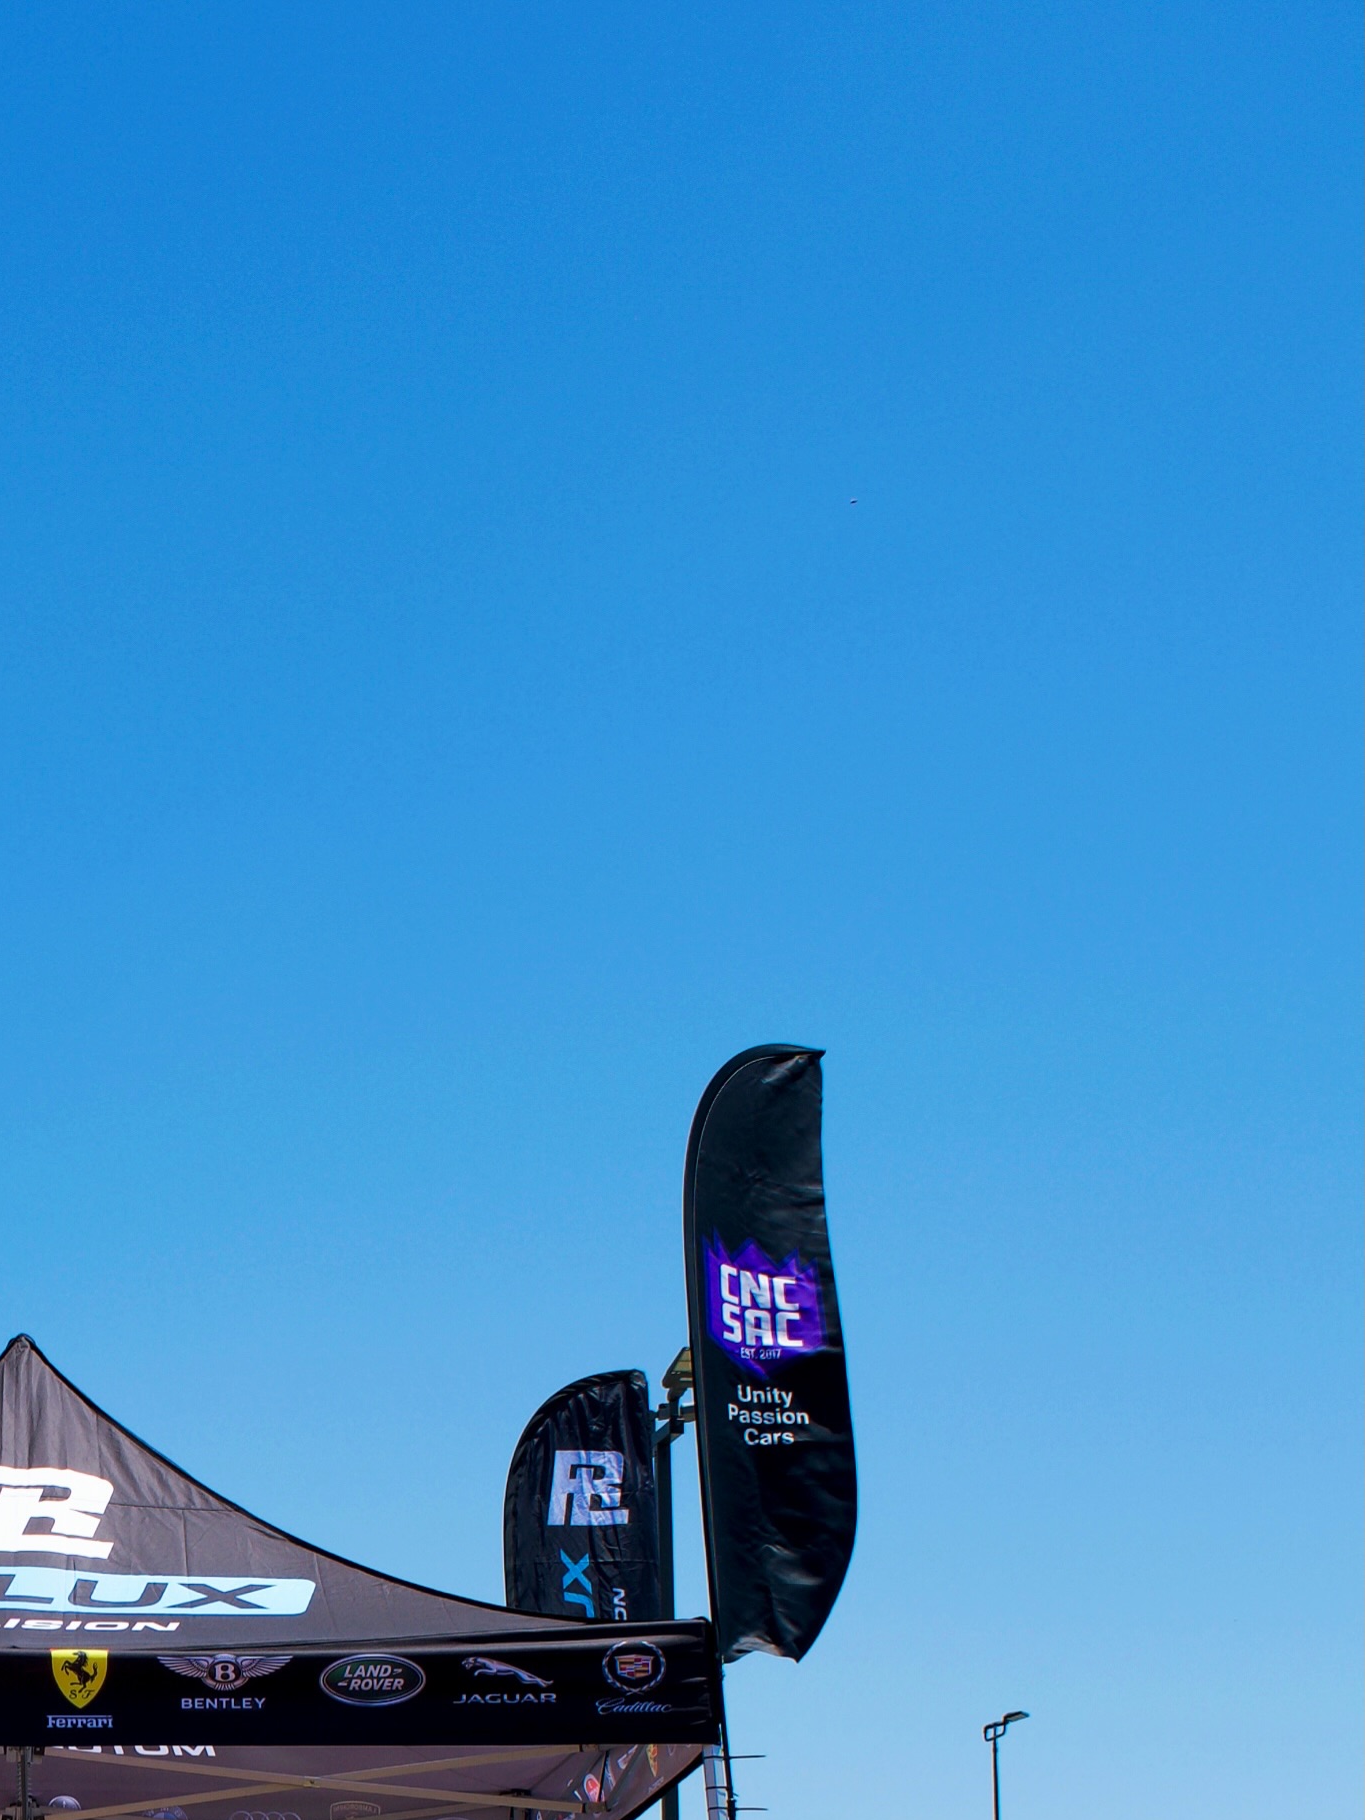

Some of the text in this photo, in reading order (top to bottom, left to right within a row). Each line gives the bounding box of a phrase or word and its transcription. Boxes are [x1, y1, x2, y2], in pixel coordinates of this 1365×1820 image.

[720, 1264, 799, 1311] CNC
[721, 1302, 804, 1347] SAC
[759, 1348, 782, 1360] 2017
[737, 1384, 793, 1408] Unity
[727, 1403, 810, 1426] Passion
[743, 1428, 795, 1446] Cars
[343, 1664, 393, 1678] LAND
[348, 1678, 406, 1692] ROVER
[180, 1697, 266, 1710] BENTLEY
[452, 1692, 557, 1705] JAGUAR
[594, 1697, 675, 1716] Cadillac
[46, 1714, 114, 1729] Ferrari
